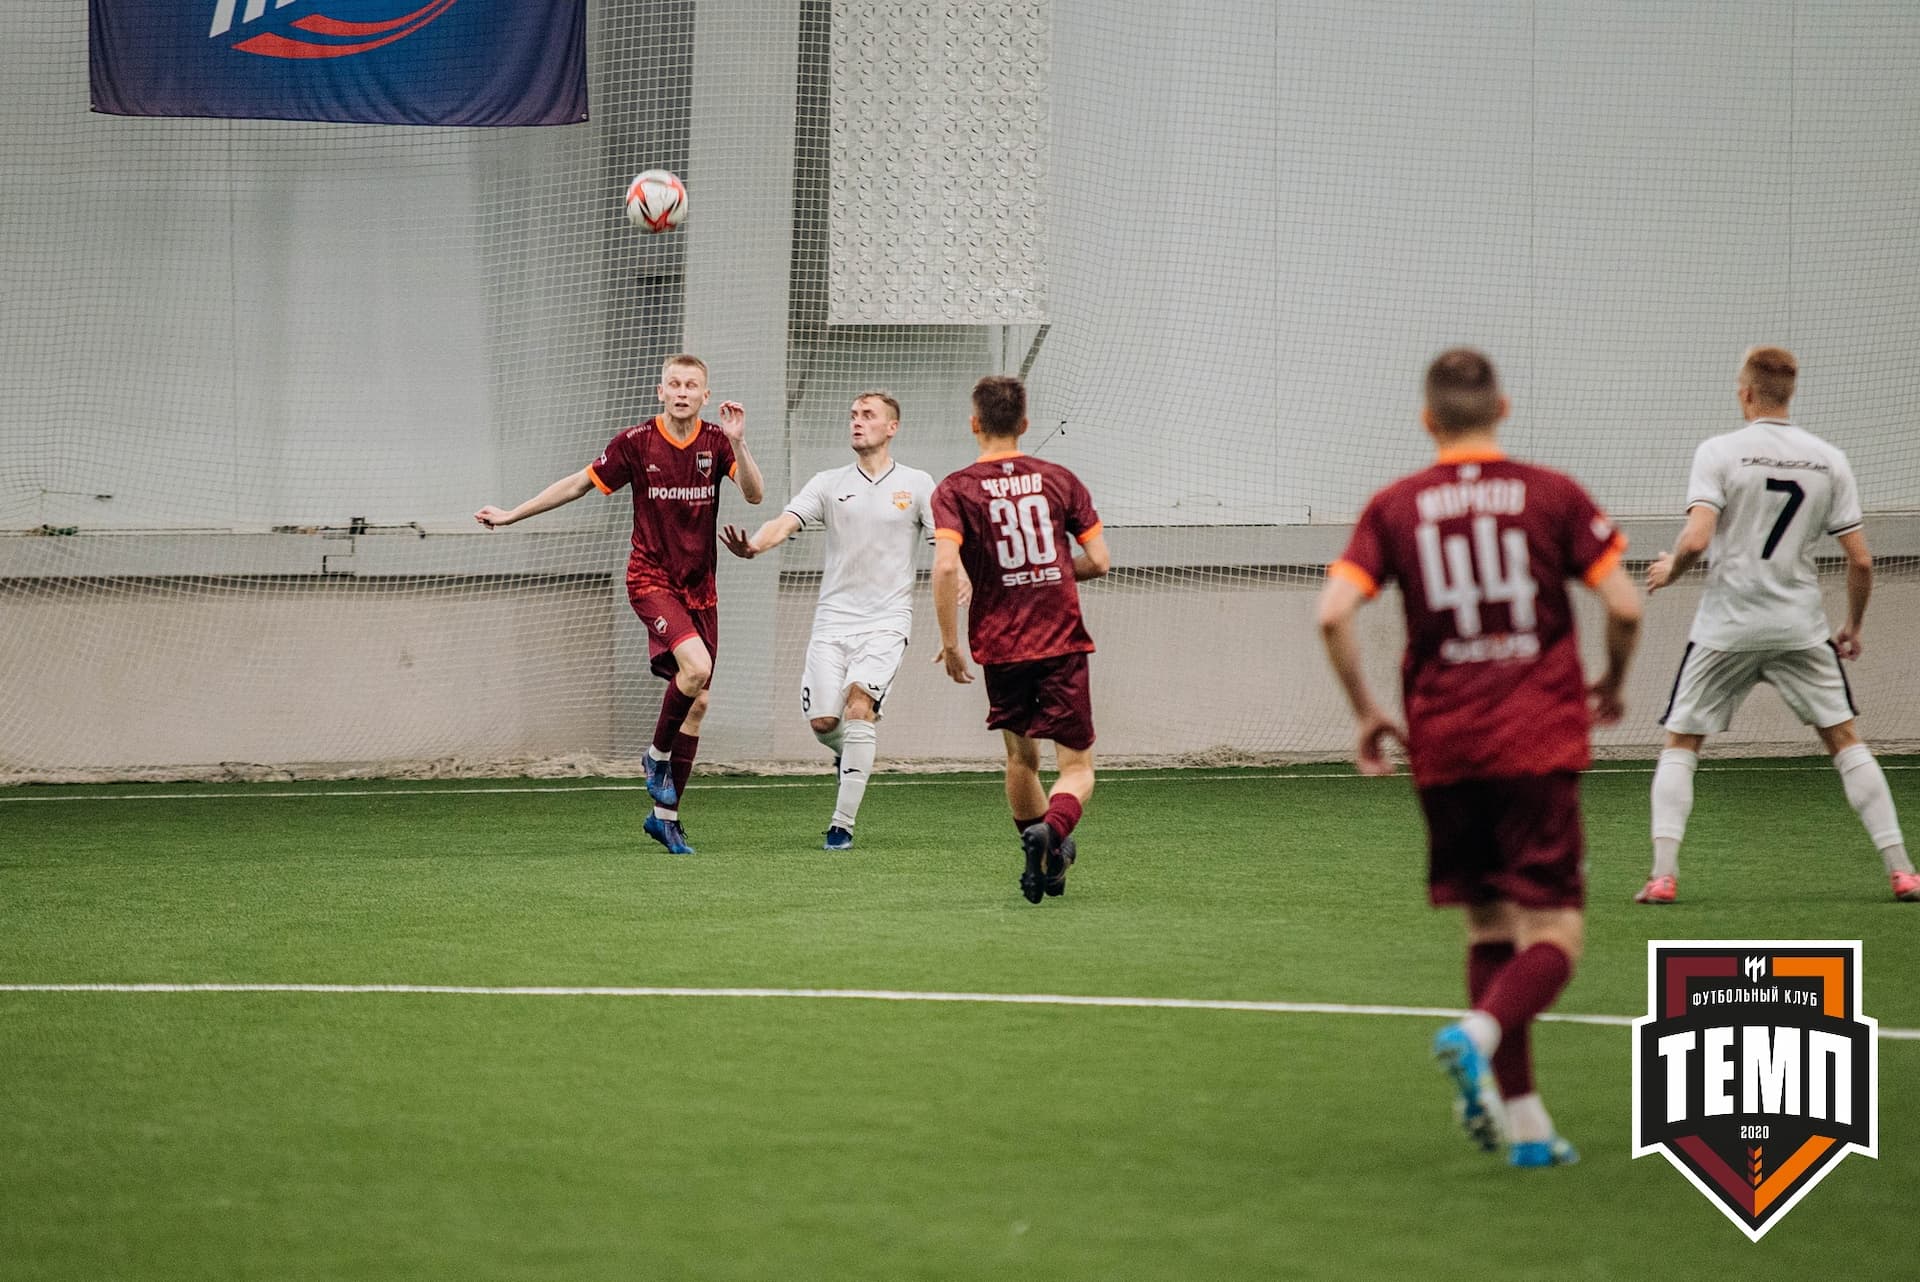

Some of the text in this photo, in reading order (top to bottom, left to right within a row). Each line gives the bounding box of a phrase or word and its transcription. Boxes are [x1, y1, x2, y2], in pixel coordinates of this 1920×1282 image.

[981, 473, 1042, 498] ЧЕРНОВ
[989, 494, 1057, 569] 30
[1761, 477, 1806, 560] 7
[1002, 566, 1062, 587] SEUS
[1415, 514, 1539, 638] 44
[802, 687, 811, 712] 8
